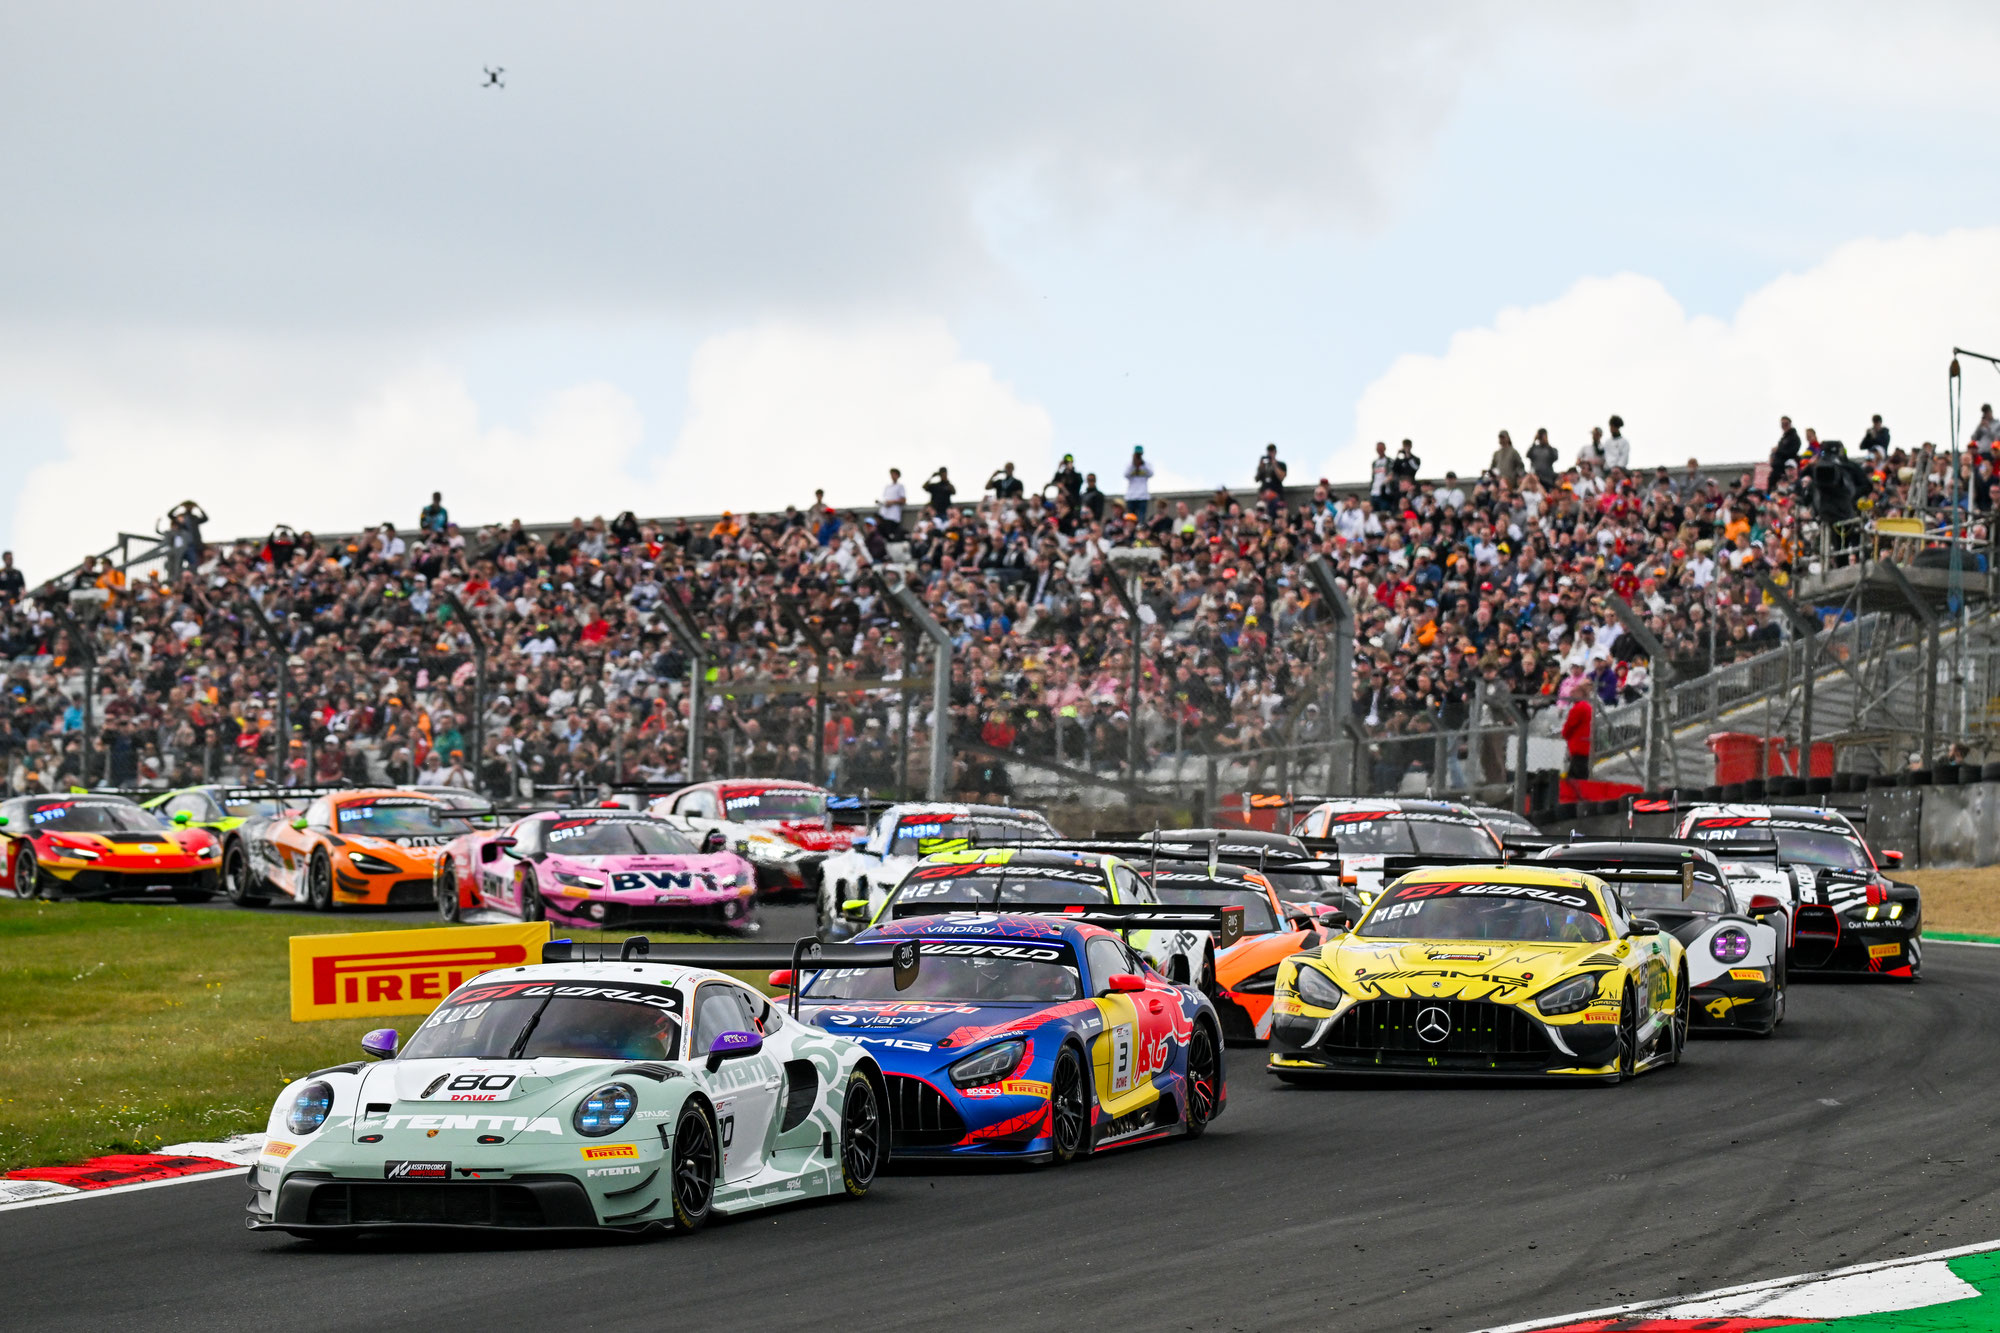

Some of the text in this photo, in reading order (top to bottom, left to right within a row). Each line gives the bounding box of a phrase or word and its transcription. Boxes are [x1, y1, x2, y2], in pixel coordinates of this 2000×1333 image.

[1332, 822, 1372, 836] PEP
[913, 863, 1104, 882] GT WORLD
[611, 872, 718, 892] BWT
[899, 880, 952, 899] HES
[1394, 882, 1588, 907] GT WORLD
[1371, 900, 1424, 923] MEN
[927, 924, 996, 935] viaplay
[1848, 921, 1861, 929] Our
[901, 945, 913, 959] aws
[920, 943, 1060, 959] WORLD
[1871, 945, 1898, 955] PIRELLI
[312, 944, 527, 1005] PIREL
[1406, 970, 1529, 988] AMG
[449, 982, 677, 1008] GT WORLD
[1585, 1012, 1617, 1022] PIRELLI
[1118, 1042, 1128, 1072] 3
[447, 1074, 517, 1091] 80
[1007, 1082, 1048, 1095] PIRELLI
[636, 1109, 671, 1118] STALOC
[719, 1115, 734, 1148] 0
[585, 1146, 635, 1158] PIRELLI
